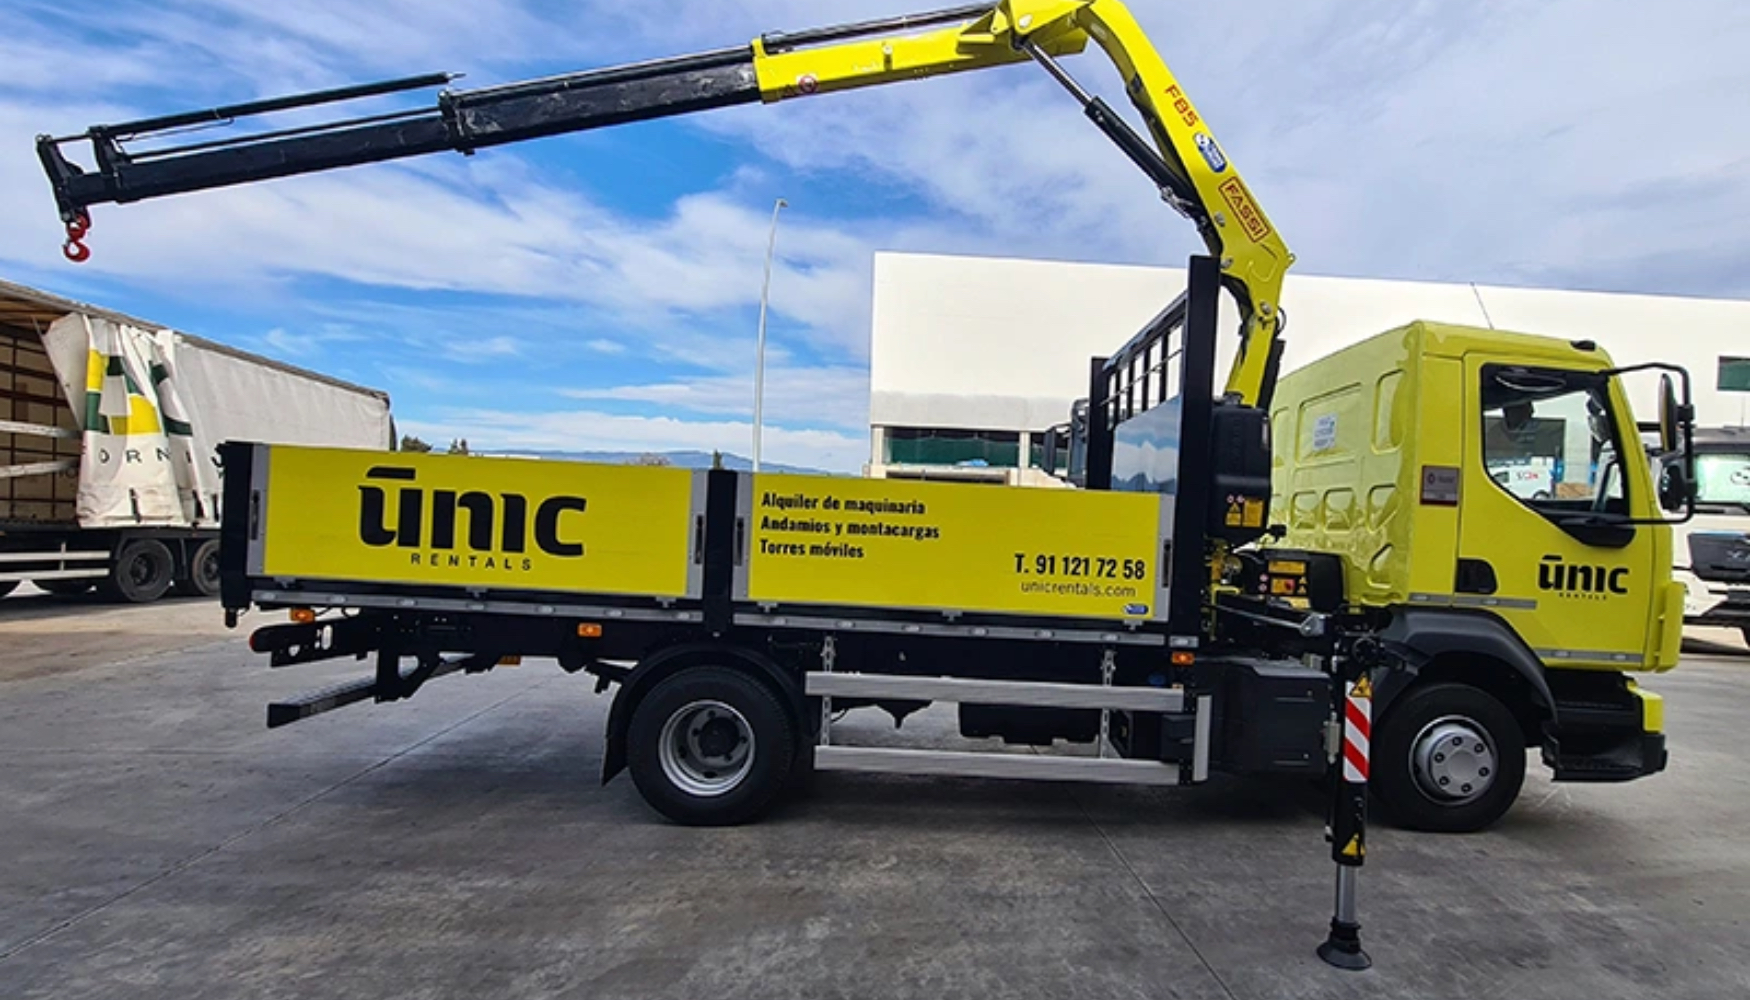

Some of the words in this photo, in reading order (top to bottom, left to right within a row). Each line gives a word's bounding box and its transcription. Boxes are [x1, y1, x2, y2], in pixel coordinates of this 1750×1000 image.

[1226, 183, 1264, 236] FASSI
[762, 492, 818, 510] Alquiler
[823, 496, 840, 510] de
[844, 498, 925, 514] maquinaria
[761, 516, 830, 533] Andamios
[835, 524, 843, 536] y
[847, 522, 940, 540] montacargas
[760, 539, 806, 556] Torres
[809, 541, 864, 558] móviles
[411, 553, 532, 572] RENTALS
[1014, 553, 1029, 573] T.
[1035, 554, 1055, 575] 91
[1063, 556, 1090, 576] 121
[1096, 558, 1117, 578] 72
[1122, 559, 1145, 580] 58
[1021, 581, 1136, 597] unicrentals.com
